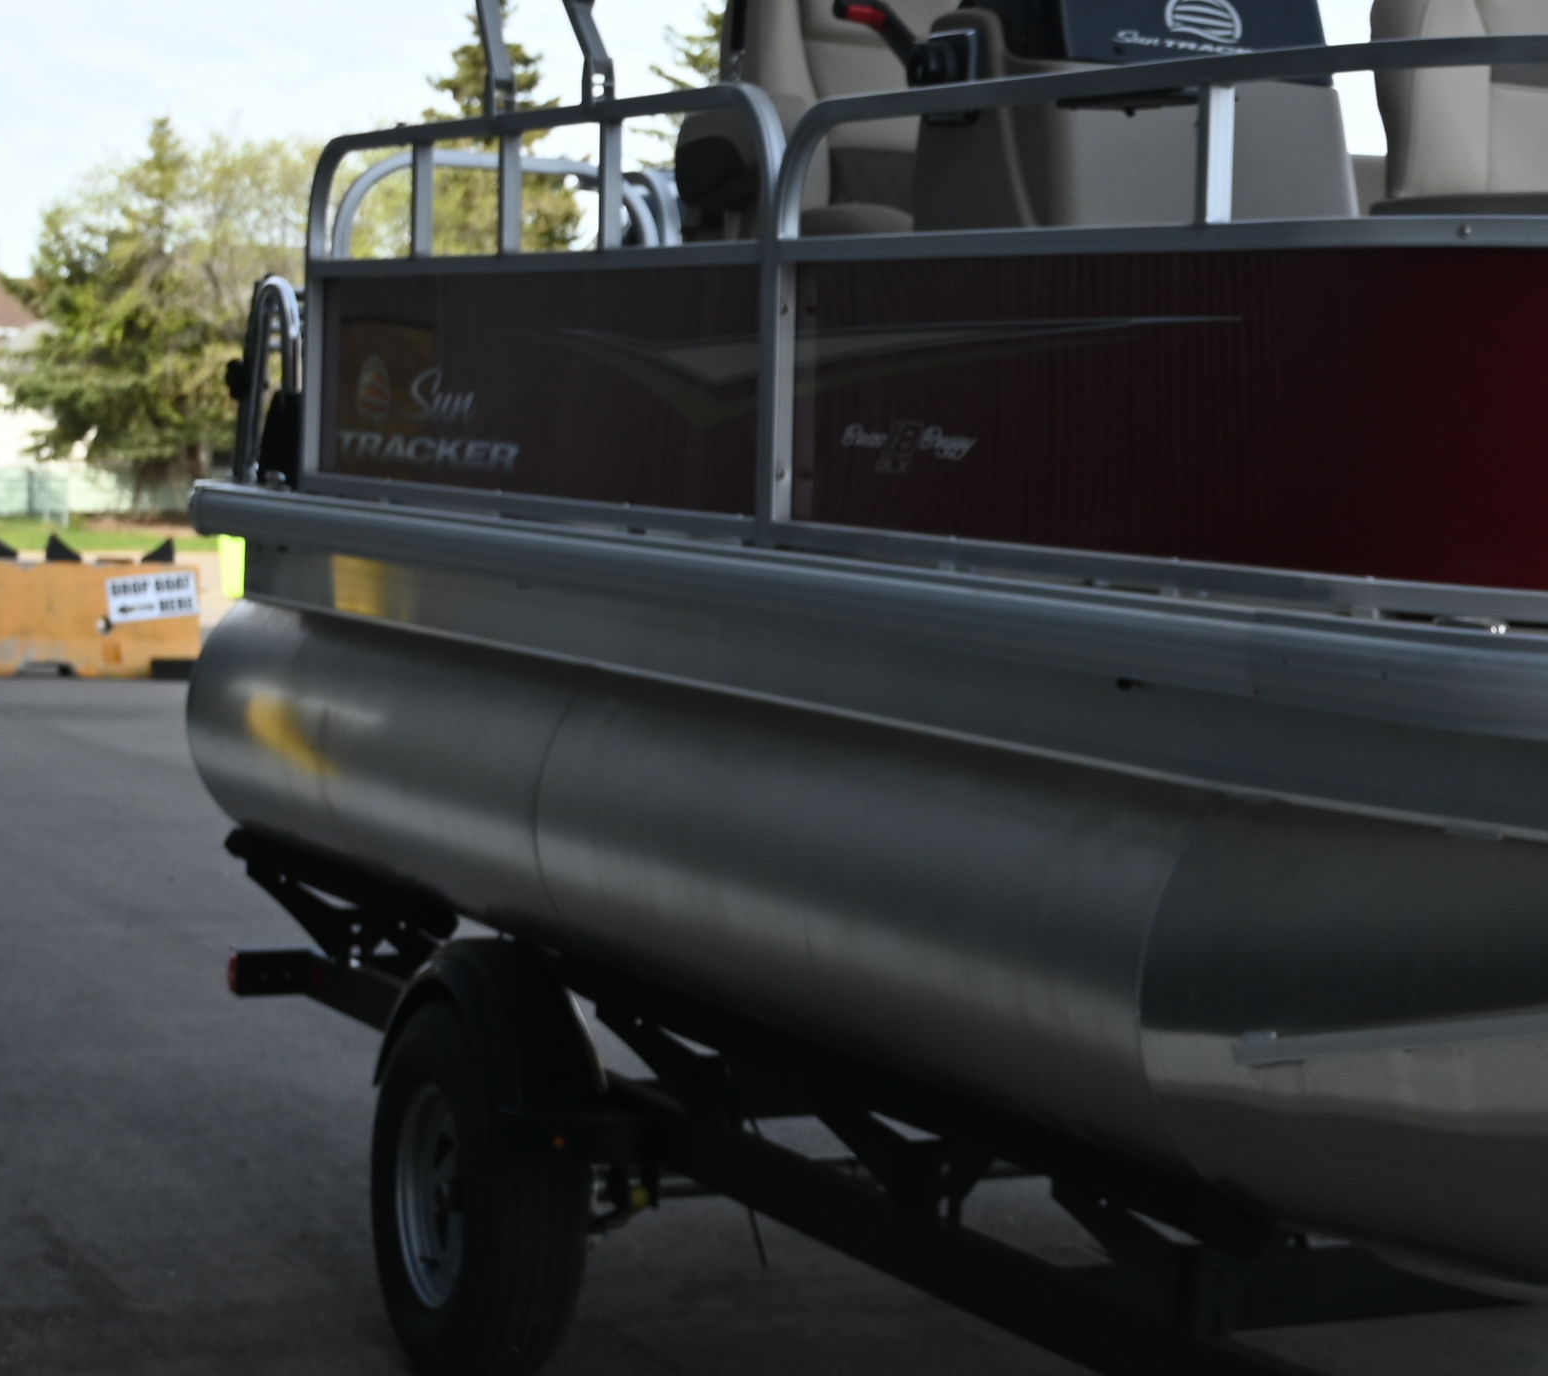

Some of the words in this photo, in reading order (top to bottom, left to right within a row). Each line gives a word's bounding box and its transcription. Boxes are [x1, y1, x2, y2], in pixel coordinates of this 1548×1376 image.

[1112, 29, 1159, 46] Sun
[404, 367, 475, 422] Sun
[339, 430, 520, 472] TRACKER
